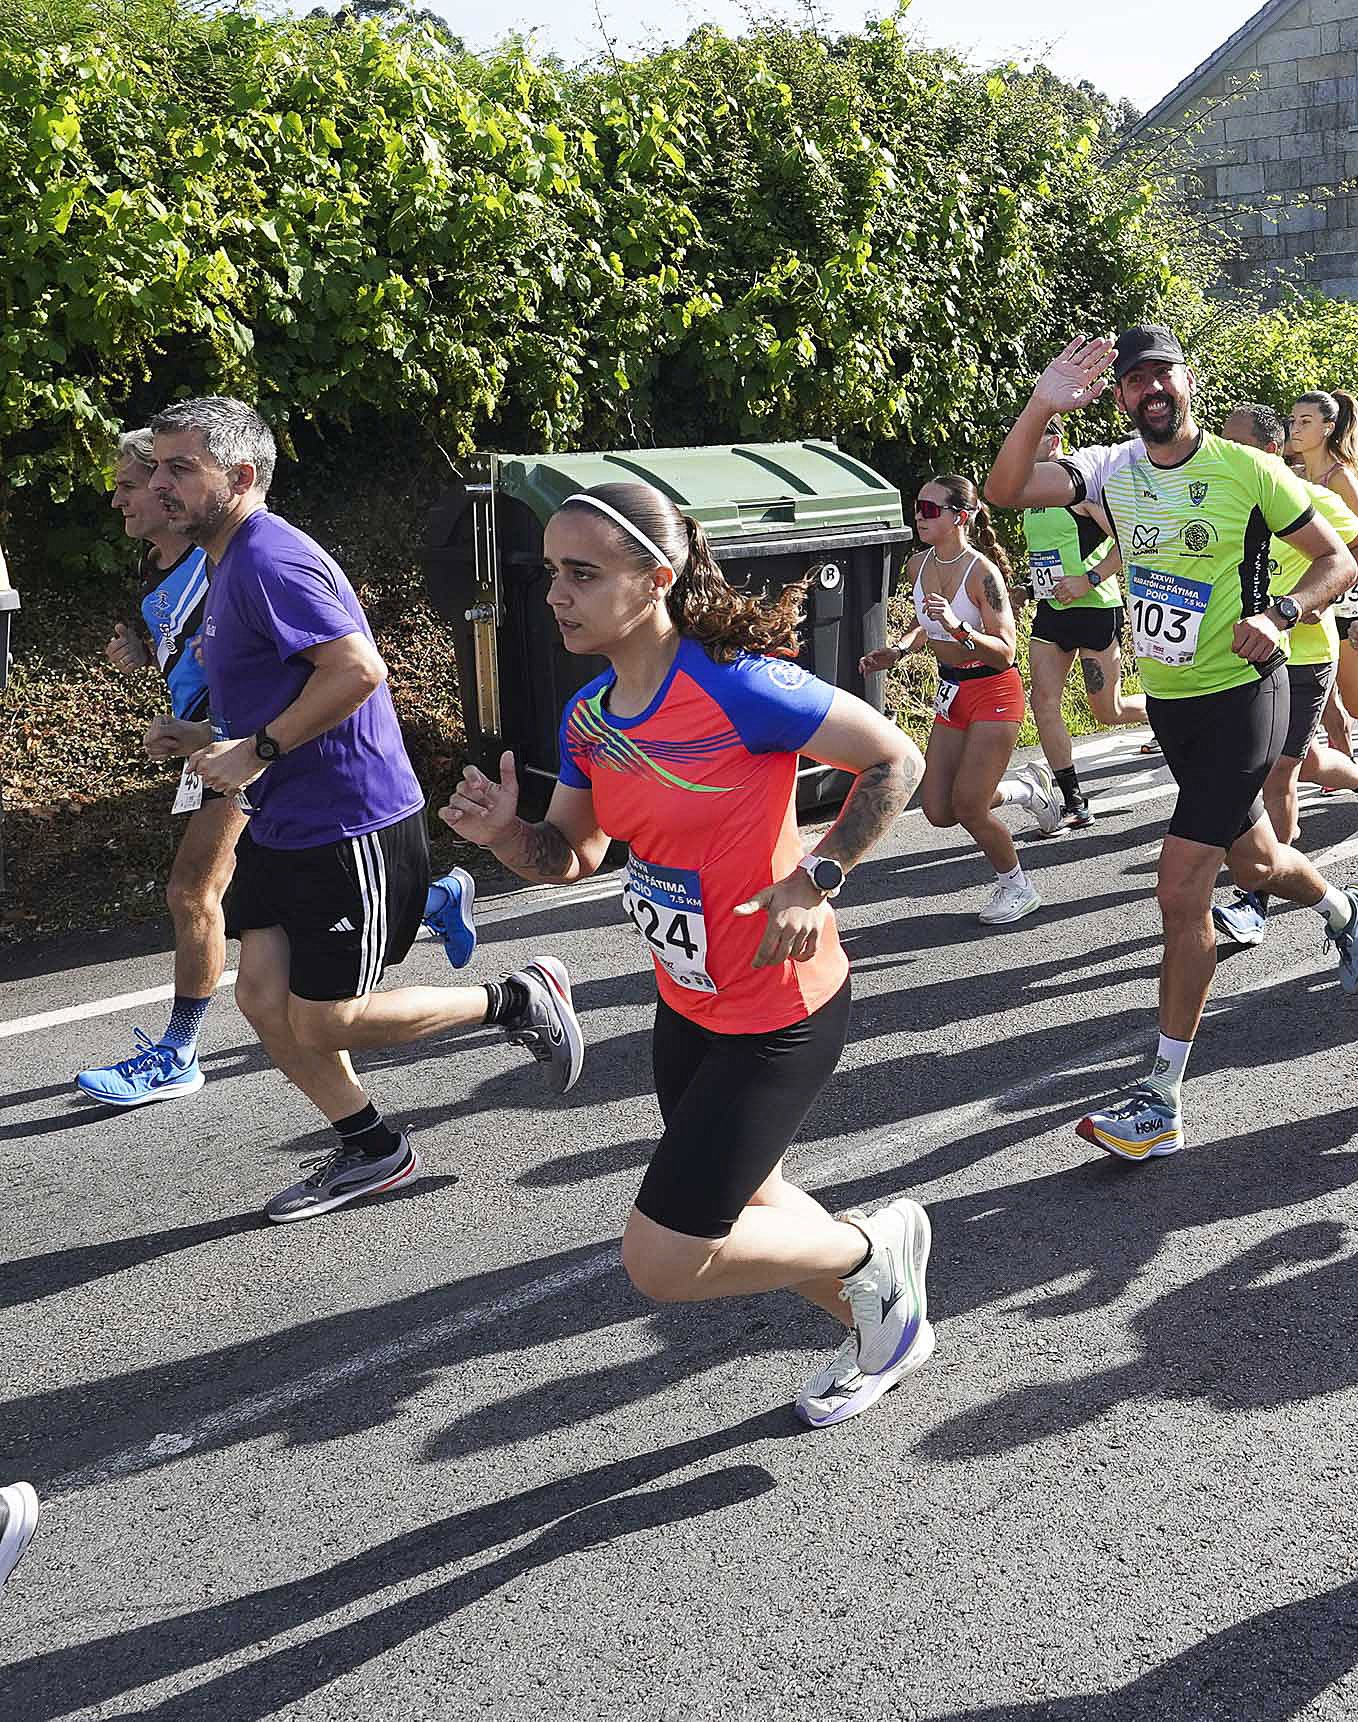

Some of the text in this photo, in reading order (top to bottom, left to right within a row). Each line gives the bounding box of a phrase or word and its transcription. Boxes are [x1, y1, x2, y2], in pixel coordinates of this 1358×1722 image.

[1036, 567, 1054, 586] 81
[1150, 572, 1175, 584] XXXVII
[1145, 589, 1169, 601] POIO
[1184, 598, 1195, 606] 7.5
[1166, 584, 1199, 602] FÁTIMA
[1133, 599, 1192, 643] 103
[646, 874, 687, 895] FÁTIMA
[669, 894, 685, 905] 7.5
[686, 897, 702, 908] KM
[1135, 1117, 1163, 1135] HOKA
